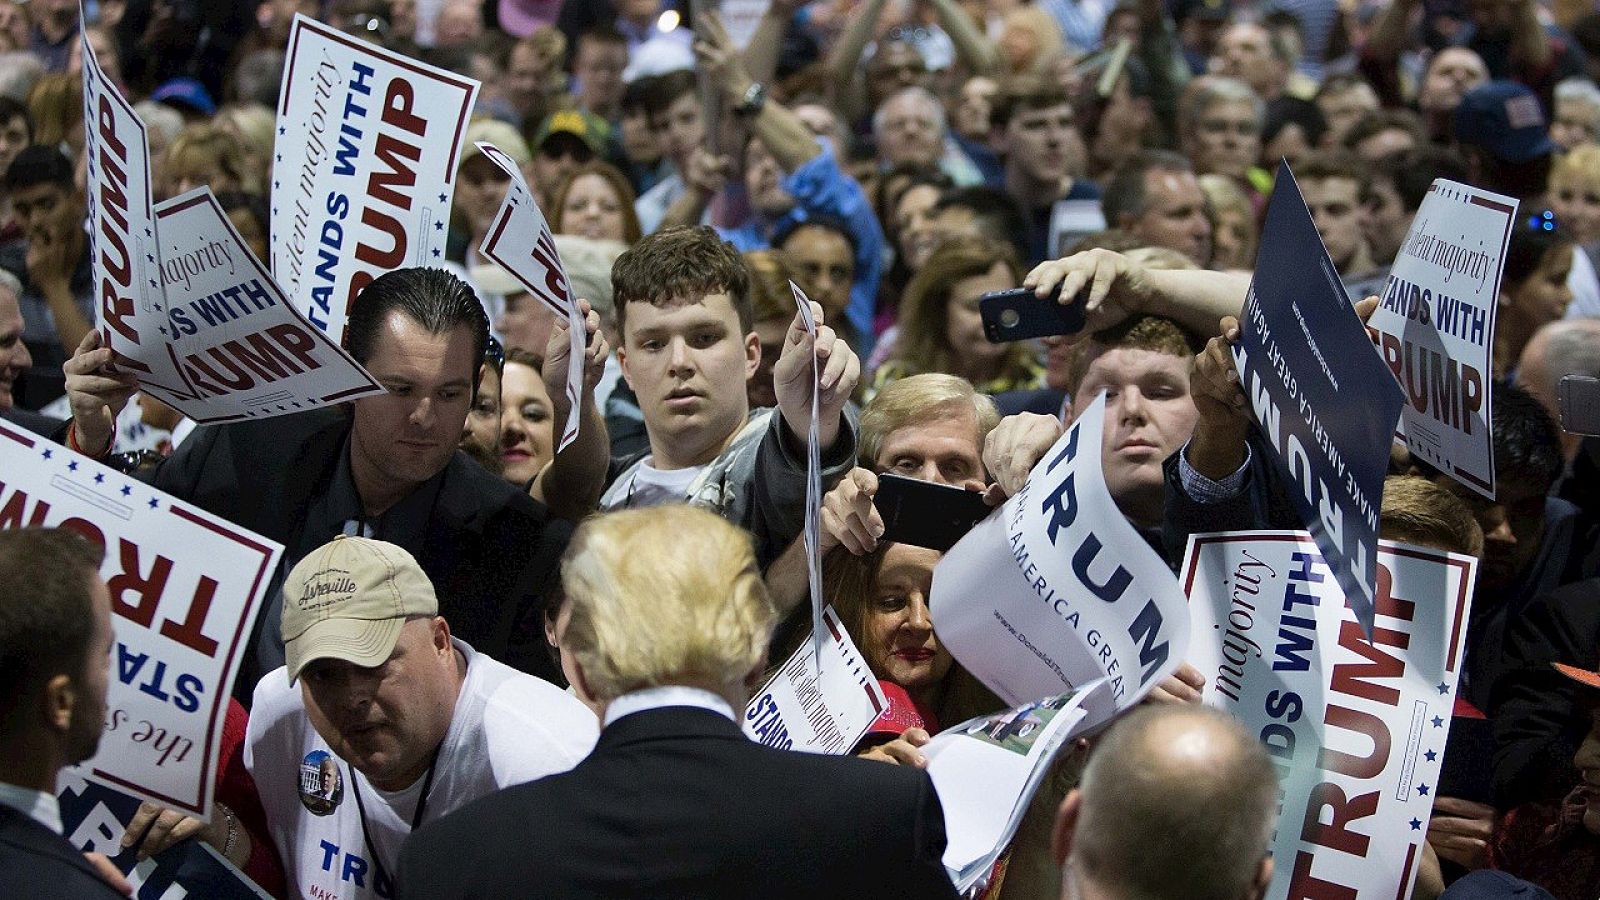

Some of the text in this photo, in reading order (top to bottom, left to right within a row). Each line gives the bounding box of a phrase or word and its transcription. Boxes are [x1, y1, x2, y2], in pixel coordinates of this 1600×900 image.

[300, 48, 342, 198] majority
[99, 92, 153, 375] TRUMP
[309, 61, 375, 331] TANDS WITH
[342, 77, 428, 330] UMP
[286, 198, 310, 293] silent
[1405, 219, 1496, 295] ilent majority
[189, 278, 277, 327] WITH
[1379, 274, 1432, 326] TANDS
[1436, 292, 1487, 347] WITH
[1267, 340, 1297, 399] GREAT
[1299, 392, 1346, 479] AMERICA
[1345, 472, 1377, 533] MAKE
[298, 577, 358, 606] Asheville
[1010, 531, 1080, 630] AMERICA
[1086, 629, 1126, 702] GREAT
[1214, 550, 1277, 702] majority
[1272, 551, 1326, 672] WITH
[117, 643, 205, 713] STA
[131, 719, 194, 767] the
